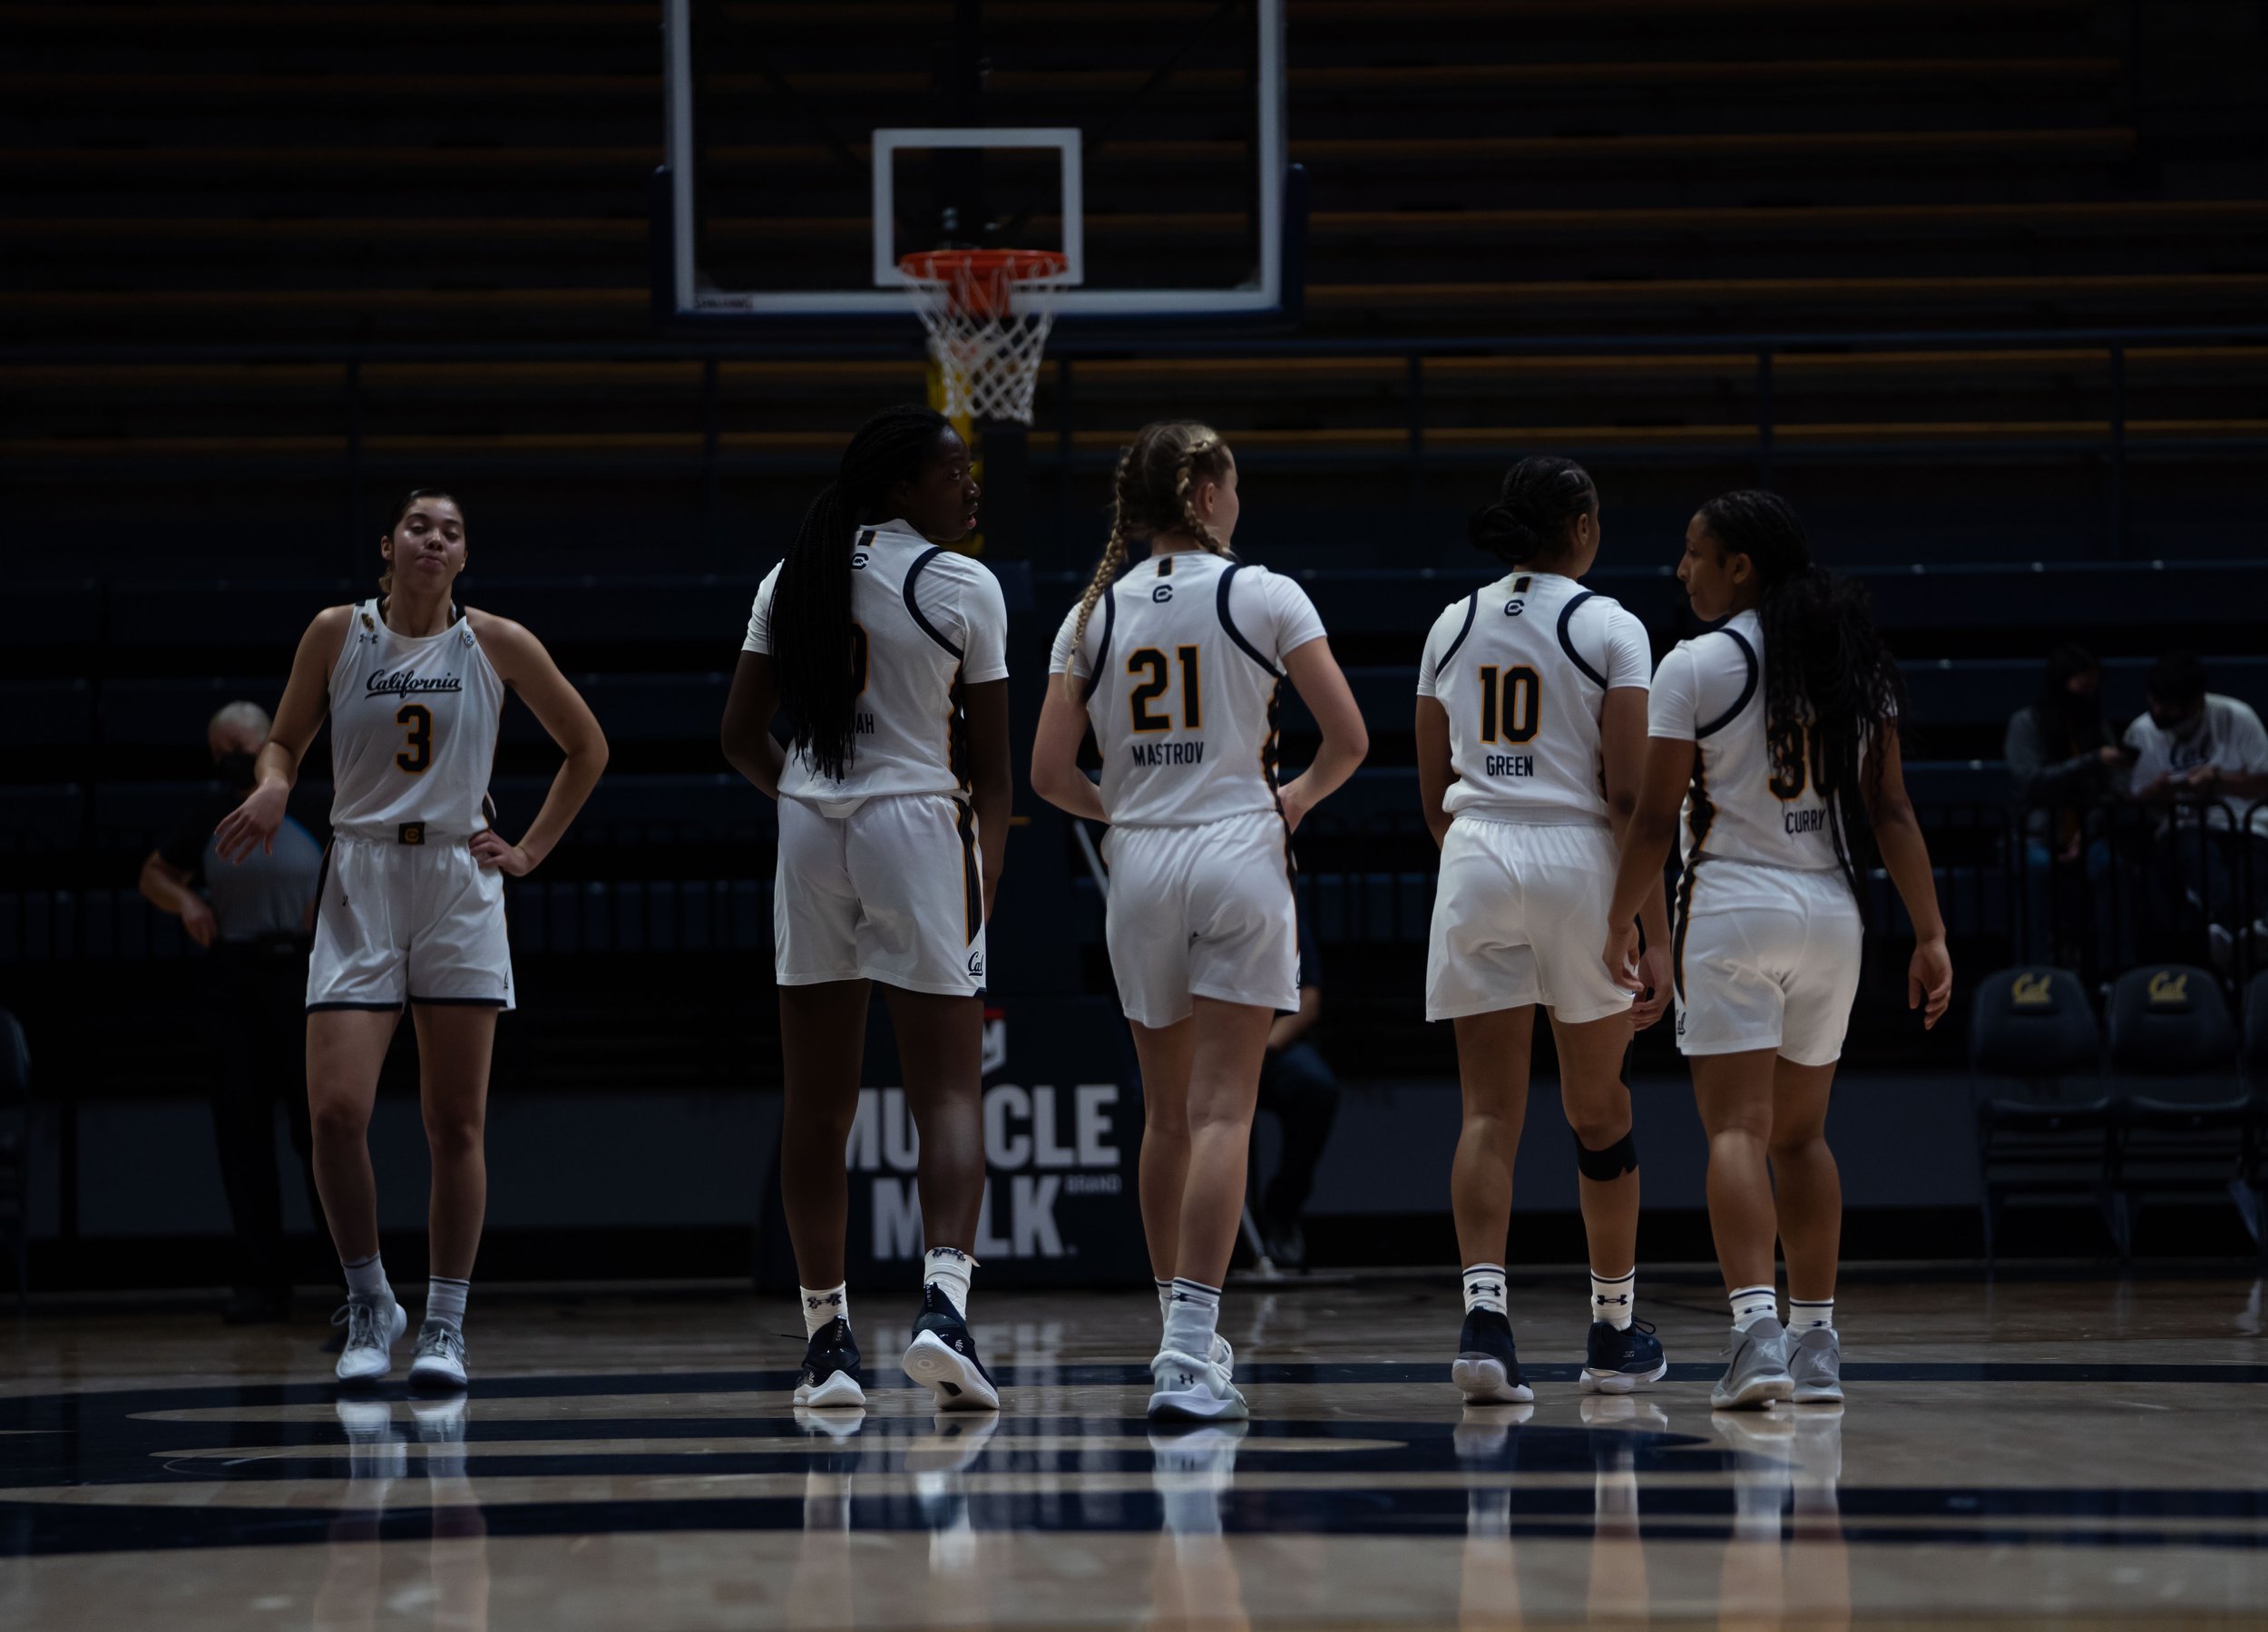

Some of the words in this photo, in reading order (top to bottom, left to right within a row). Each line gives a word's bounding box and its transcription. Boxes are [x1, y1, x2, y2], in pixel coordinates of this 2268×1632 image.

[365, 669, 463, 699] California
[1127, 645, 1199, 731] 21
[1479, 666, 1541, 744] 10
[395, 704, 432, 775] 3
[1131, 741, 1205, 767] MASTROV
[1486, 756, 1533, 777] GREEN
[1784, 808, 1826, 835] CURRY
[968, 951, 983, 976] Cal
[2011, 972, 2053, 1004] Cal
[2148, 971, 2188, 1003] Cal
[845, 1083, 1120, 1171] MUCLE
[872, 1175, 1067, 1261] MLK
